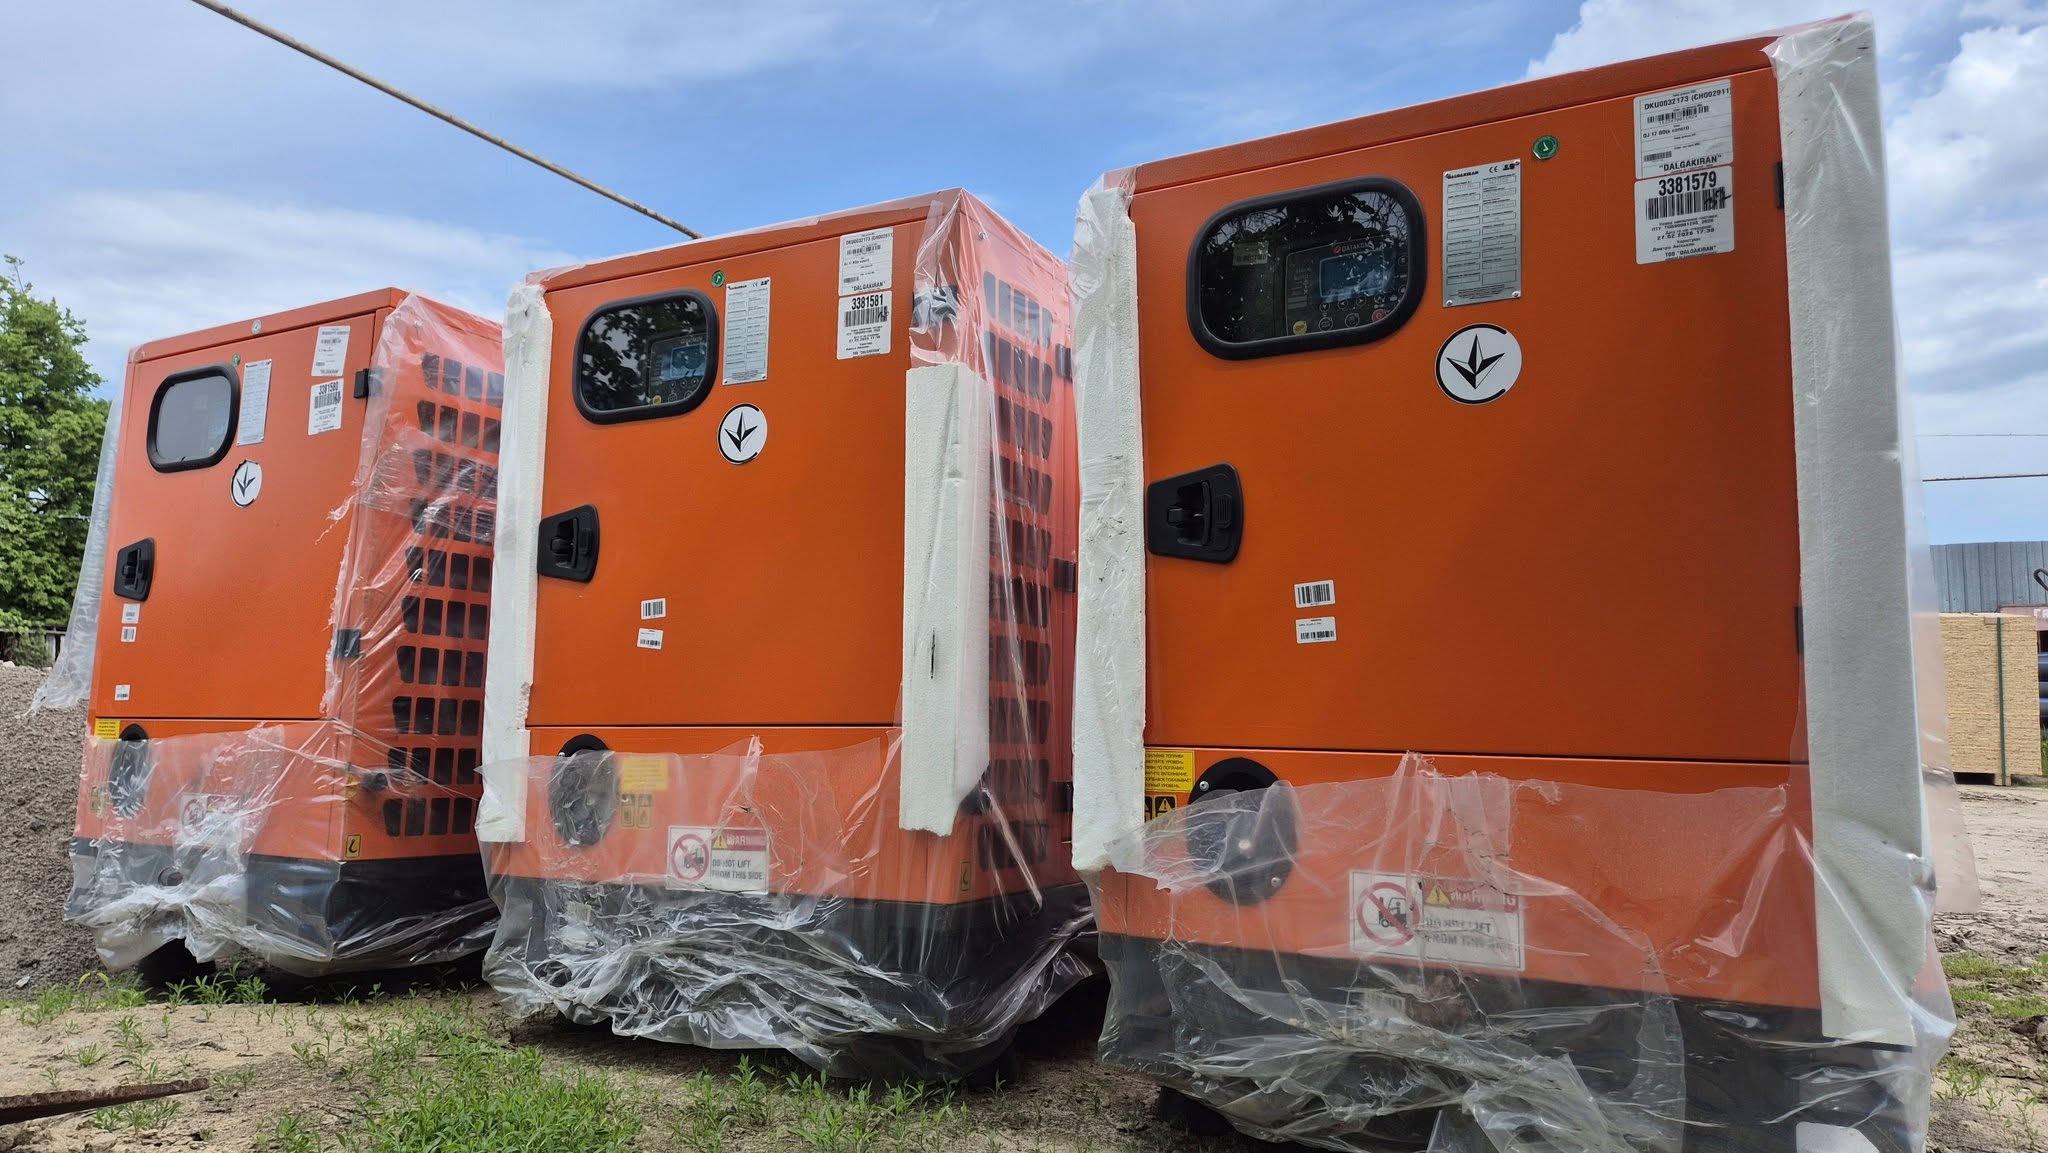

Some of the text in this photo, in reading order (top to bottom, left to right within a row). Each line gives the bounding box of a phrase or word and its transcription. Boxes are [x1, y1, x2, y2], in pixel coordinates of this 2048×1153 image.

[1645, 96, 1689, 110] DKU0032173
[1691, 88, 1731, 102] (CH002911
[1659, 154, 1721, 172] "DALGAKIRAN"
[1658, 171, 1717, 196] 3381579
[851, 294, 884, 310] 3381581
